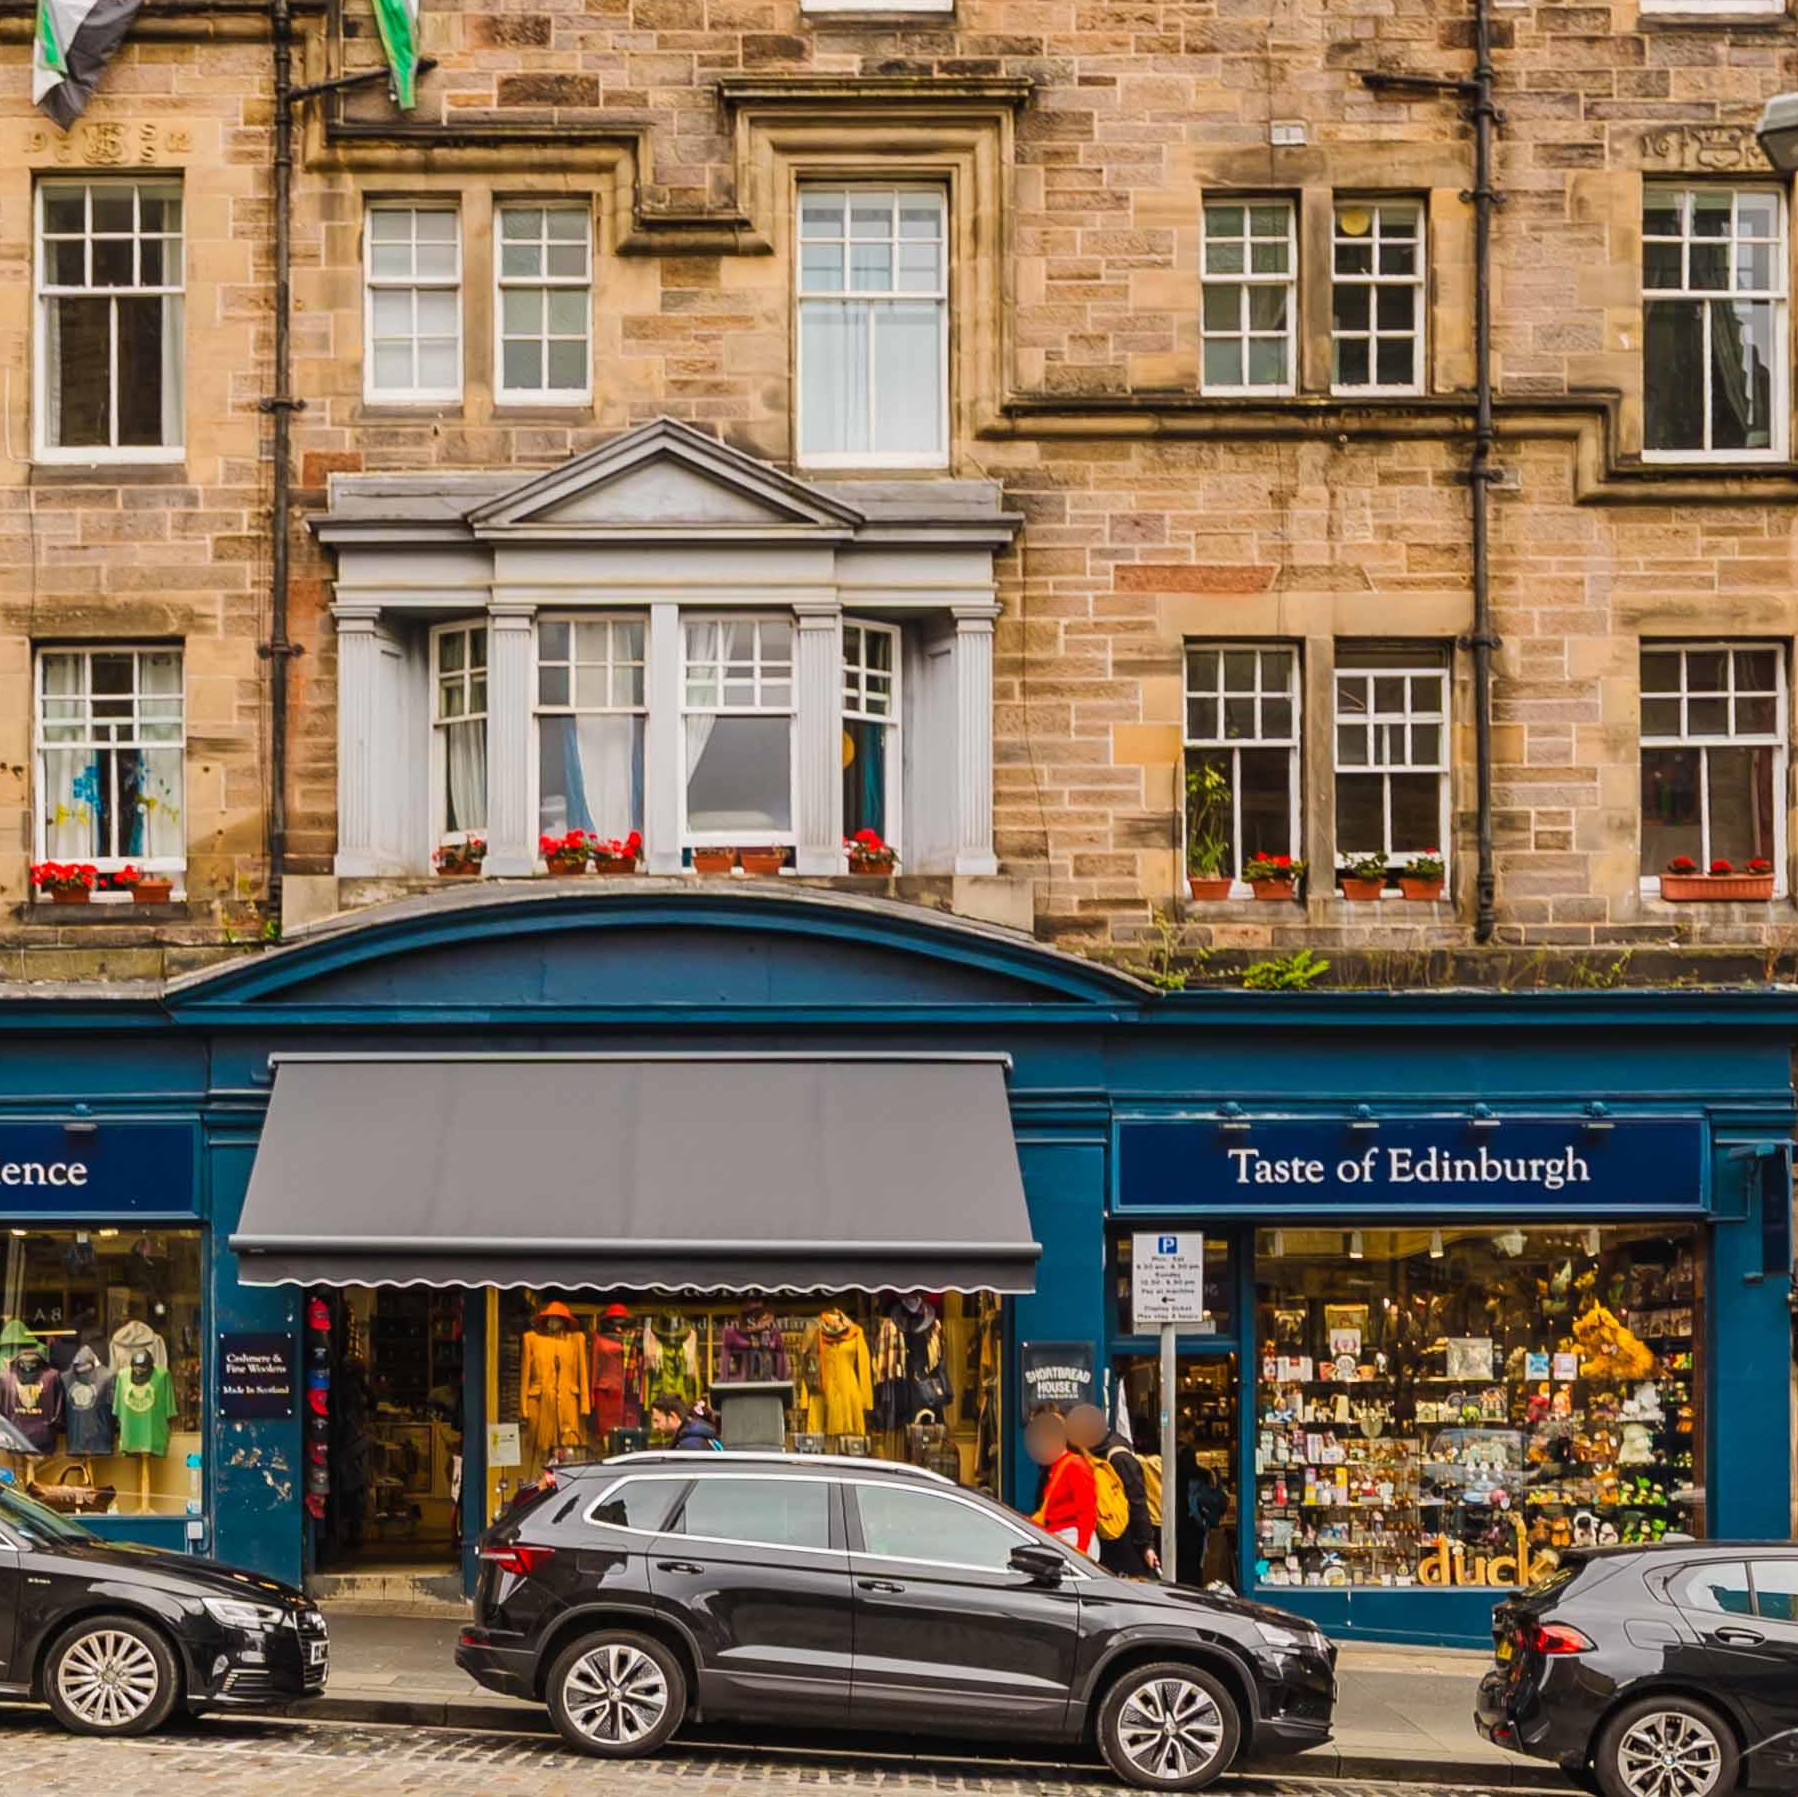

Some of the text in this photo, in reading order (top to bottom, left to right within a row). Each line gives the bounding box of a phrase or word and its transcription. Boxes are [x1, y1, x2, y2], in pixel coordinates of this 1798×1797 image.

[1228, 1146, 1591, 1190] Taste of Edinburgh
[226, 1353, 271, 1362] Cashmere
[226, 1364, 247, 1373] Fine
[1025, 1366, 1091, 1383] SHORTBREAD
[223, 1386, 244, 1394] Made
[256, 1386, 290, 1394] Scotland
[1037, 1382, 1071, 1393] HOUSE
[1418, 1533, 1548, 1586] duck
